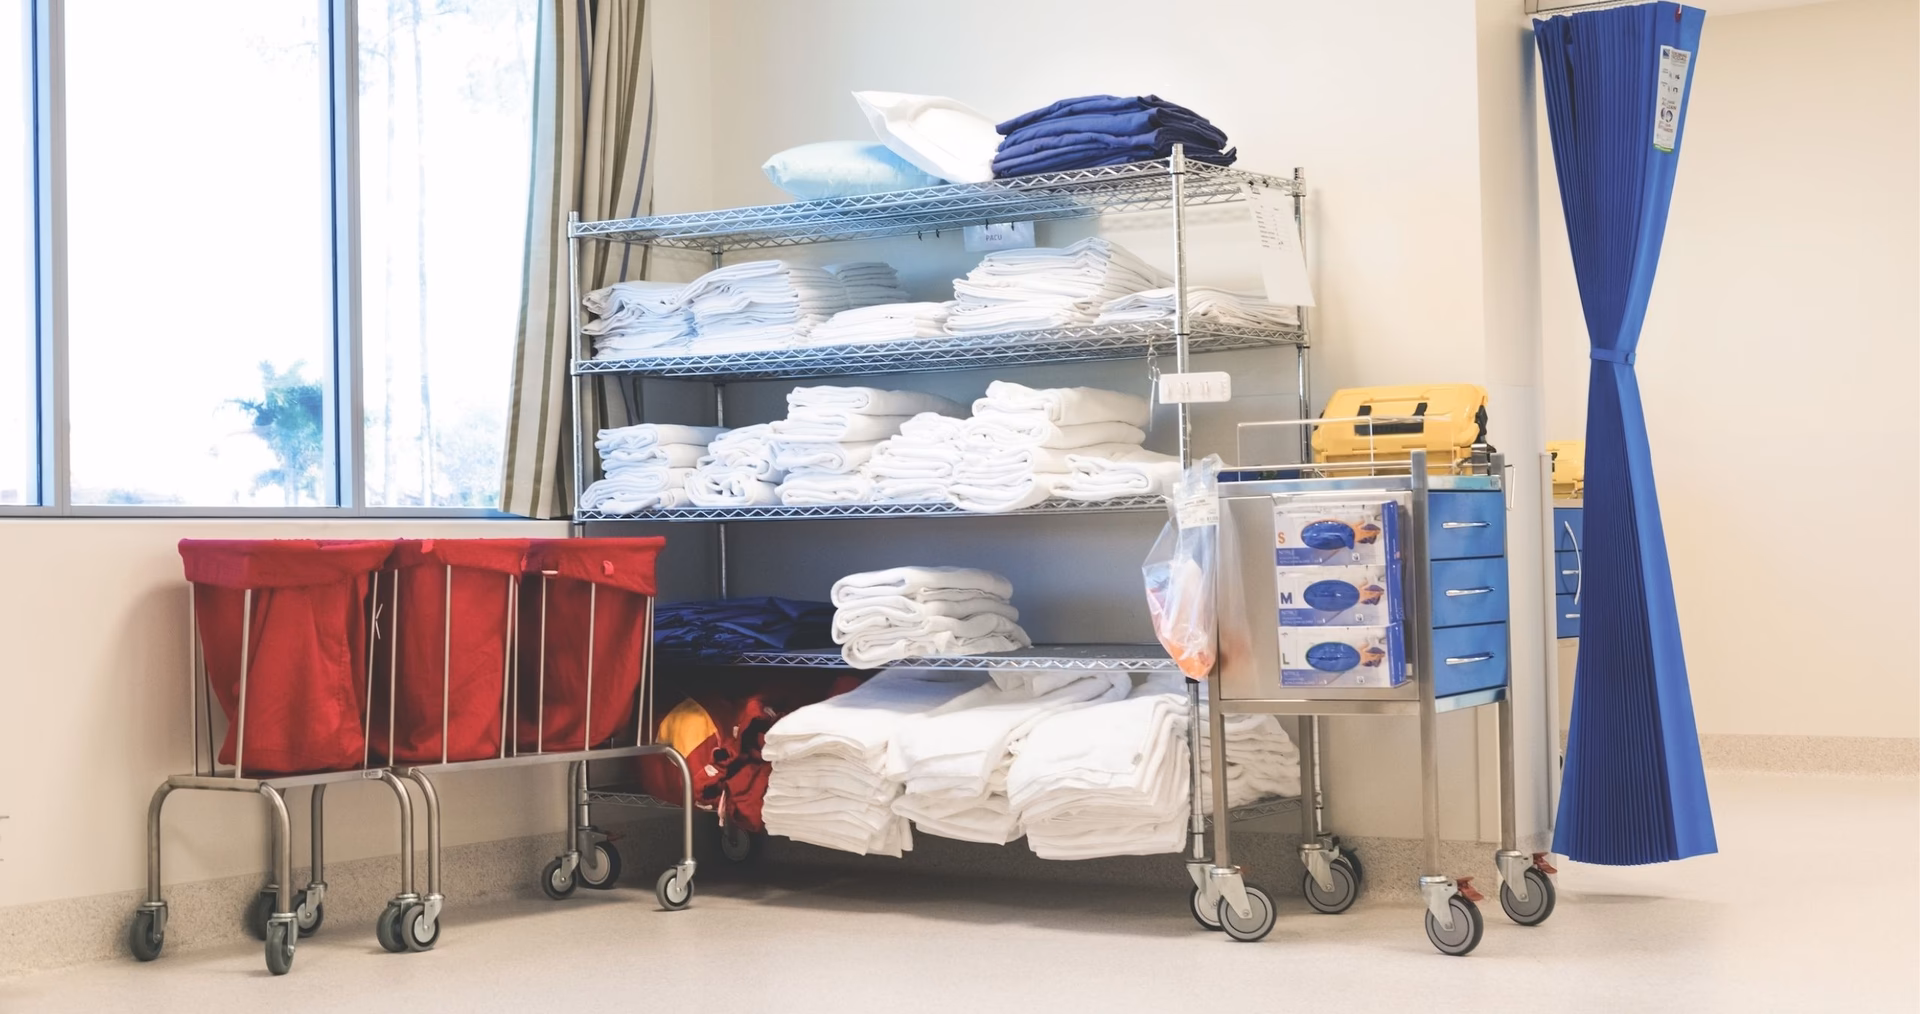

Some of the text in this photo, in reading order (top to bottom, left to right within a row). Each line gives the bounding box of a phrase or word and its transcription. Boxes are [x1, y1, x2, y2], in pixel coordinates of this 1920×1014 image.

[1278, 532, 1285, 544] S
[1280, 592, 1293, 605] M
[1283, 653, 1290, 665] L
